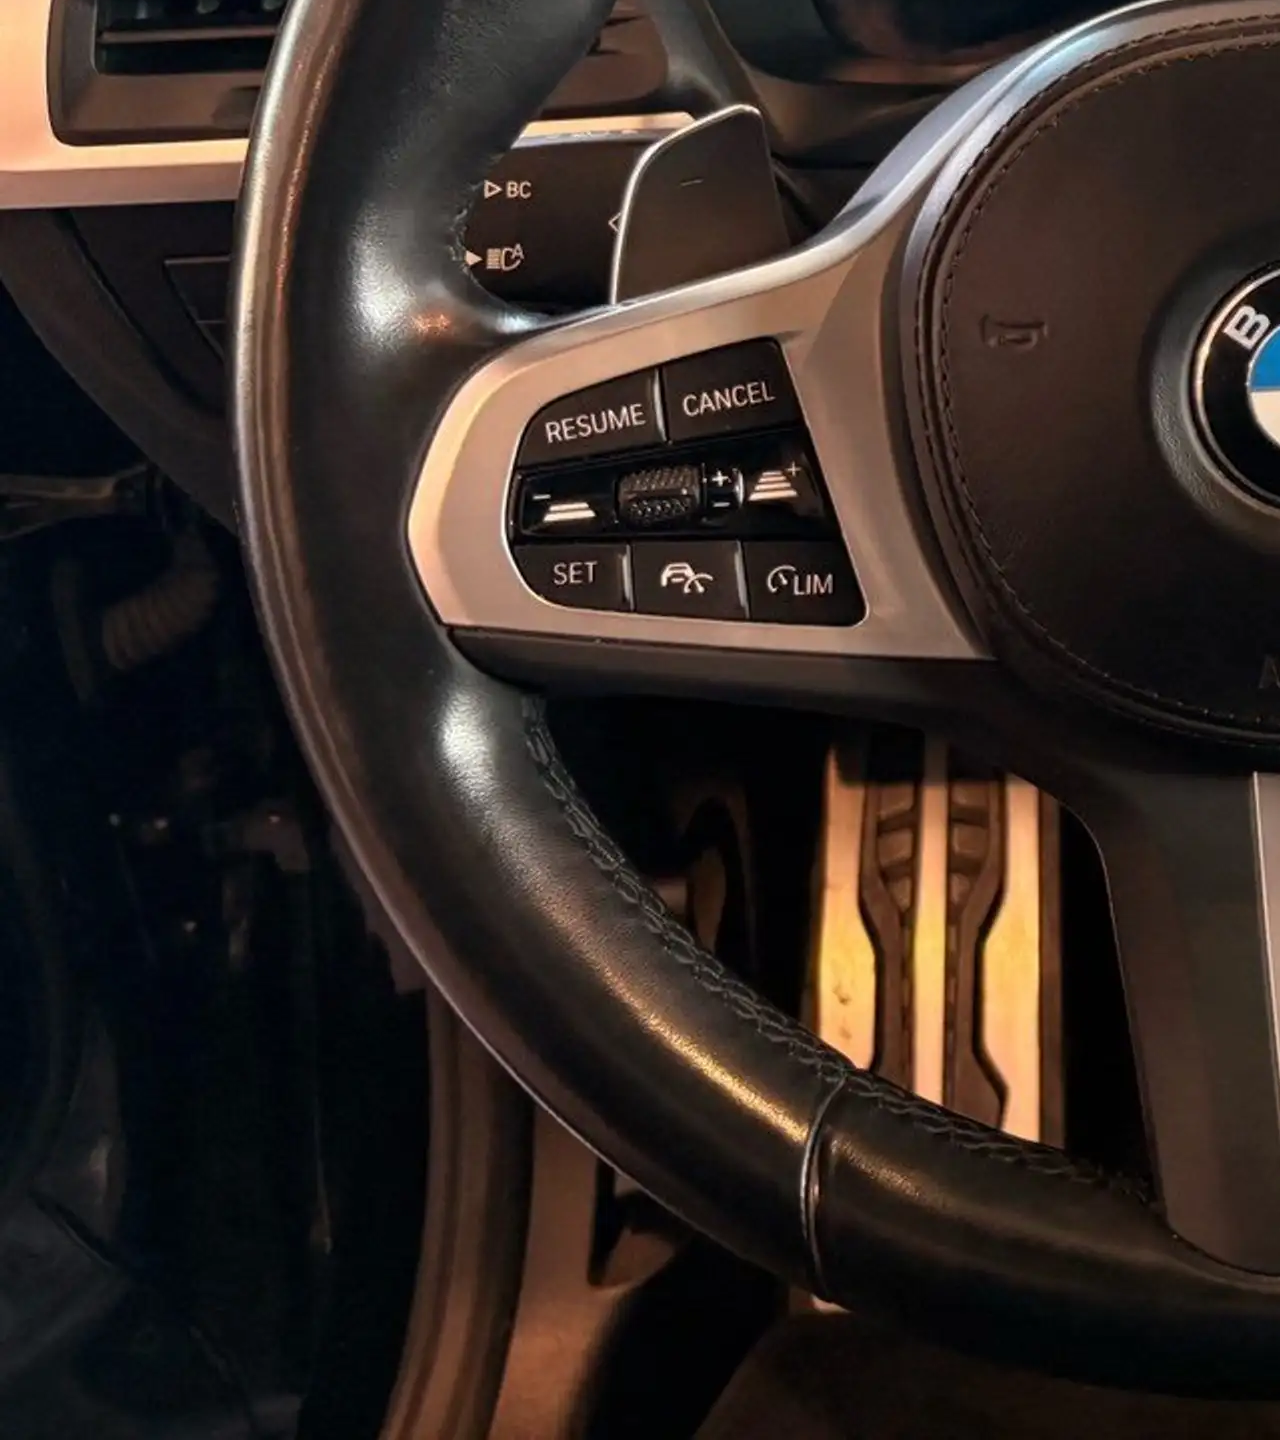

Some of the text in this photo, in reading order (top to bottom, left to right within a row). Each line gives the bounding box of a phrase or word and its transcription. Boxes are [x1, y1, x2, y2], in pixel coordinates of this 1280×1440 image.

[505, 181, 532, 199] BC
[682, 379, 778, 417] CANCEL
[544, 402, 648, 445] RESUME
[552, 561, 599, 586] SET
[792, 573, 834, 597] LIM
